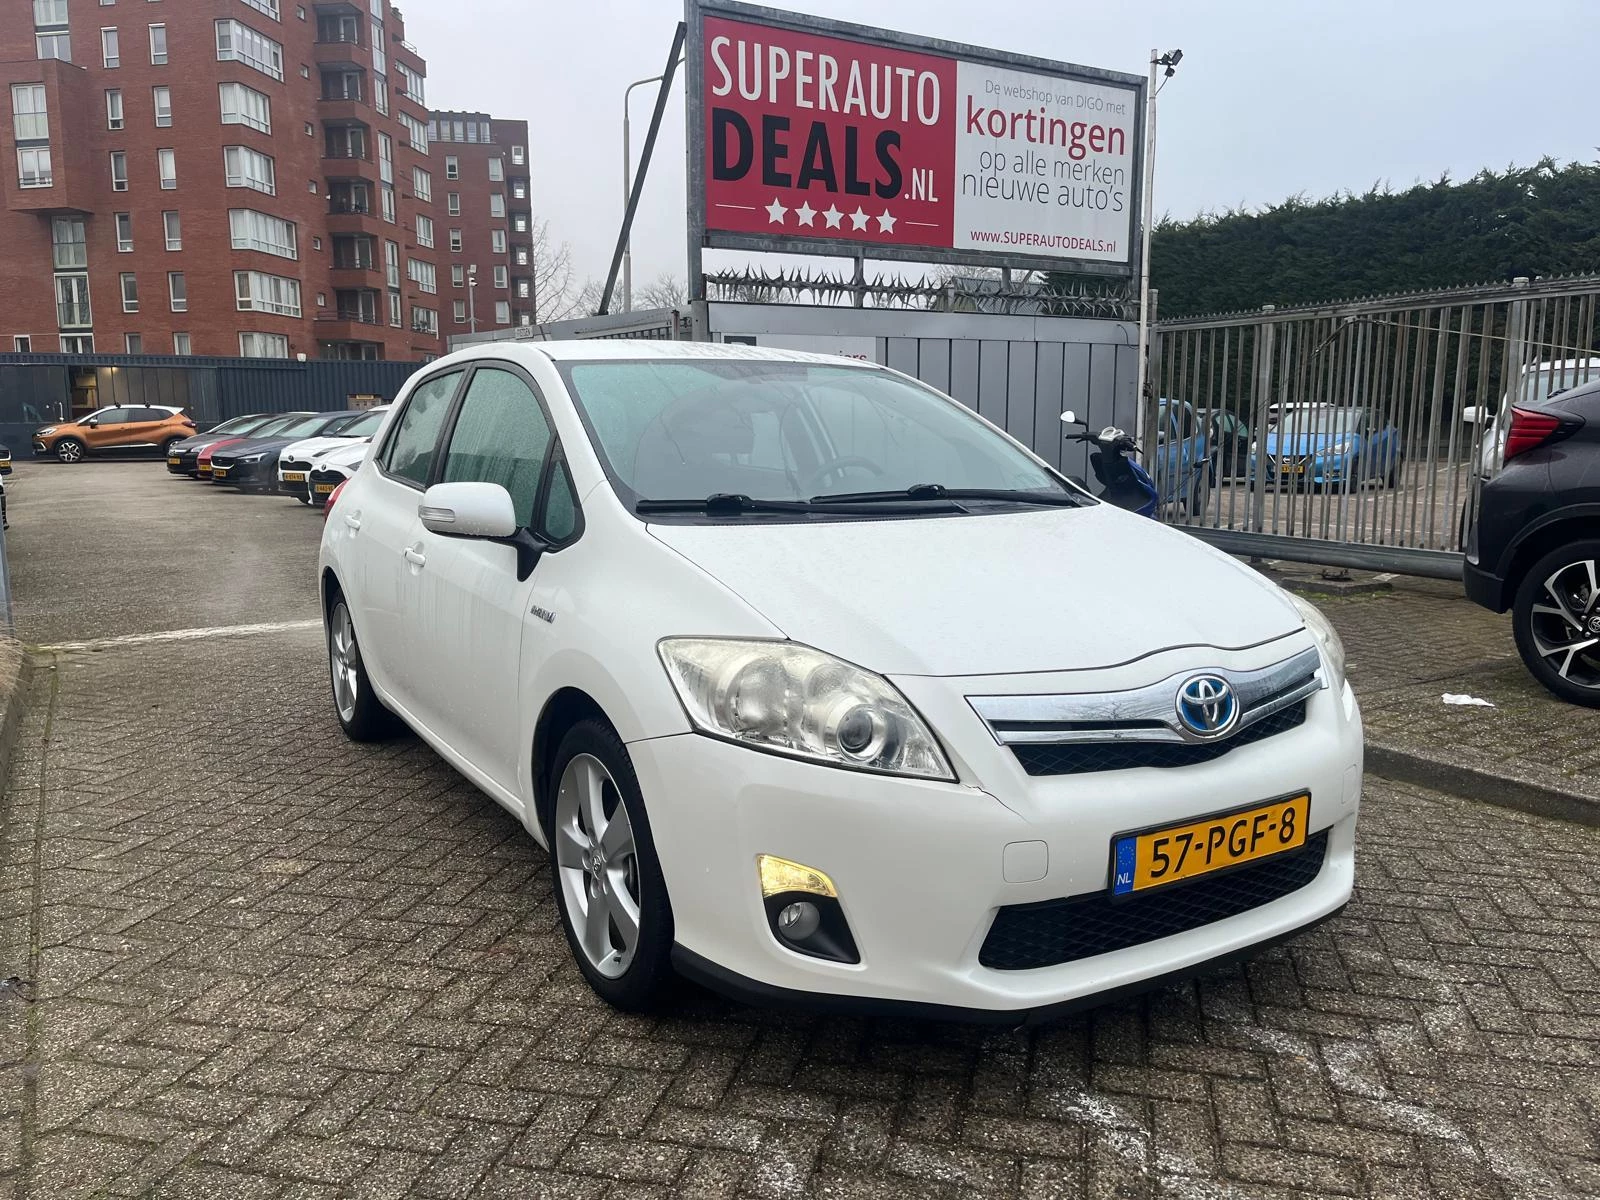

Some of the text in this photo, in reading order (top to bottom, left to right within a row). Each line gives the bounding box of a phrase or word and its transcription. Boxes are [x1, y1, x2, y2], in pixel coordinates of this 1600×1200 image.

[711, 36, 941, 126] SUPERAUTO
[985, 79, 1126, 116] De webshop van DIGO met
[966, 94, 1126, 161] kortingen
[979, 149, 1124, 186] op alle merken
[962, 169, 1124, 212] nieuwe auto's
[970, 230, 1117, 253] www.SUPERAUTODEALS.nl
[1150, 806, 1296, 878] 57-PGF-8
[1116, 872, 1132, 886] NL
